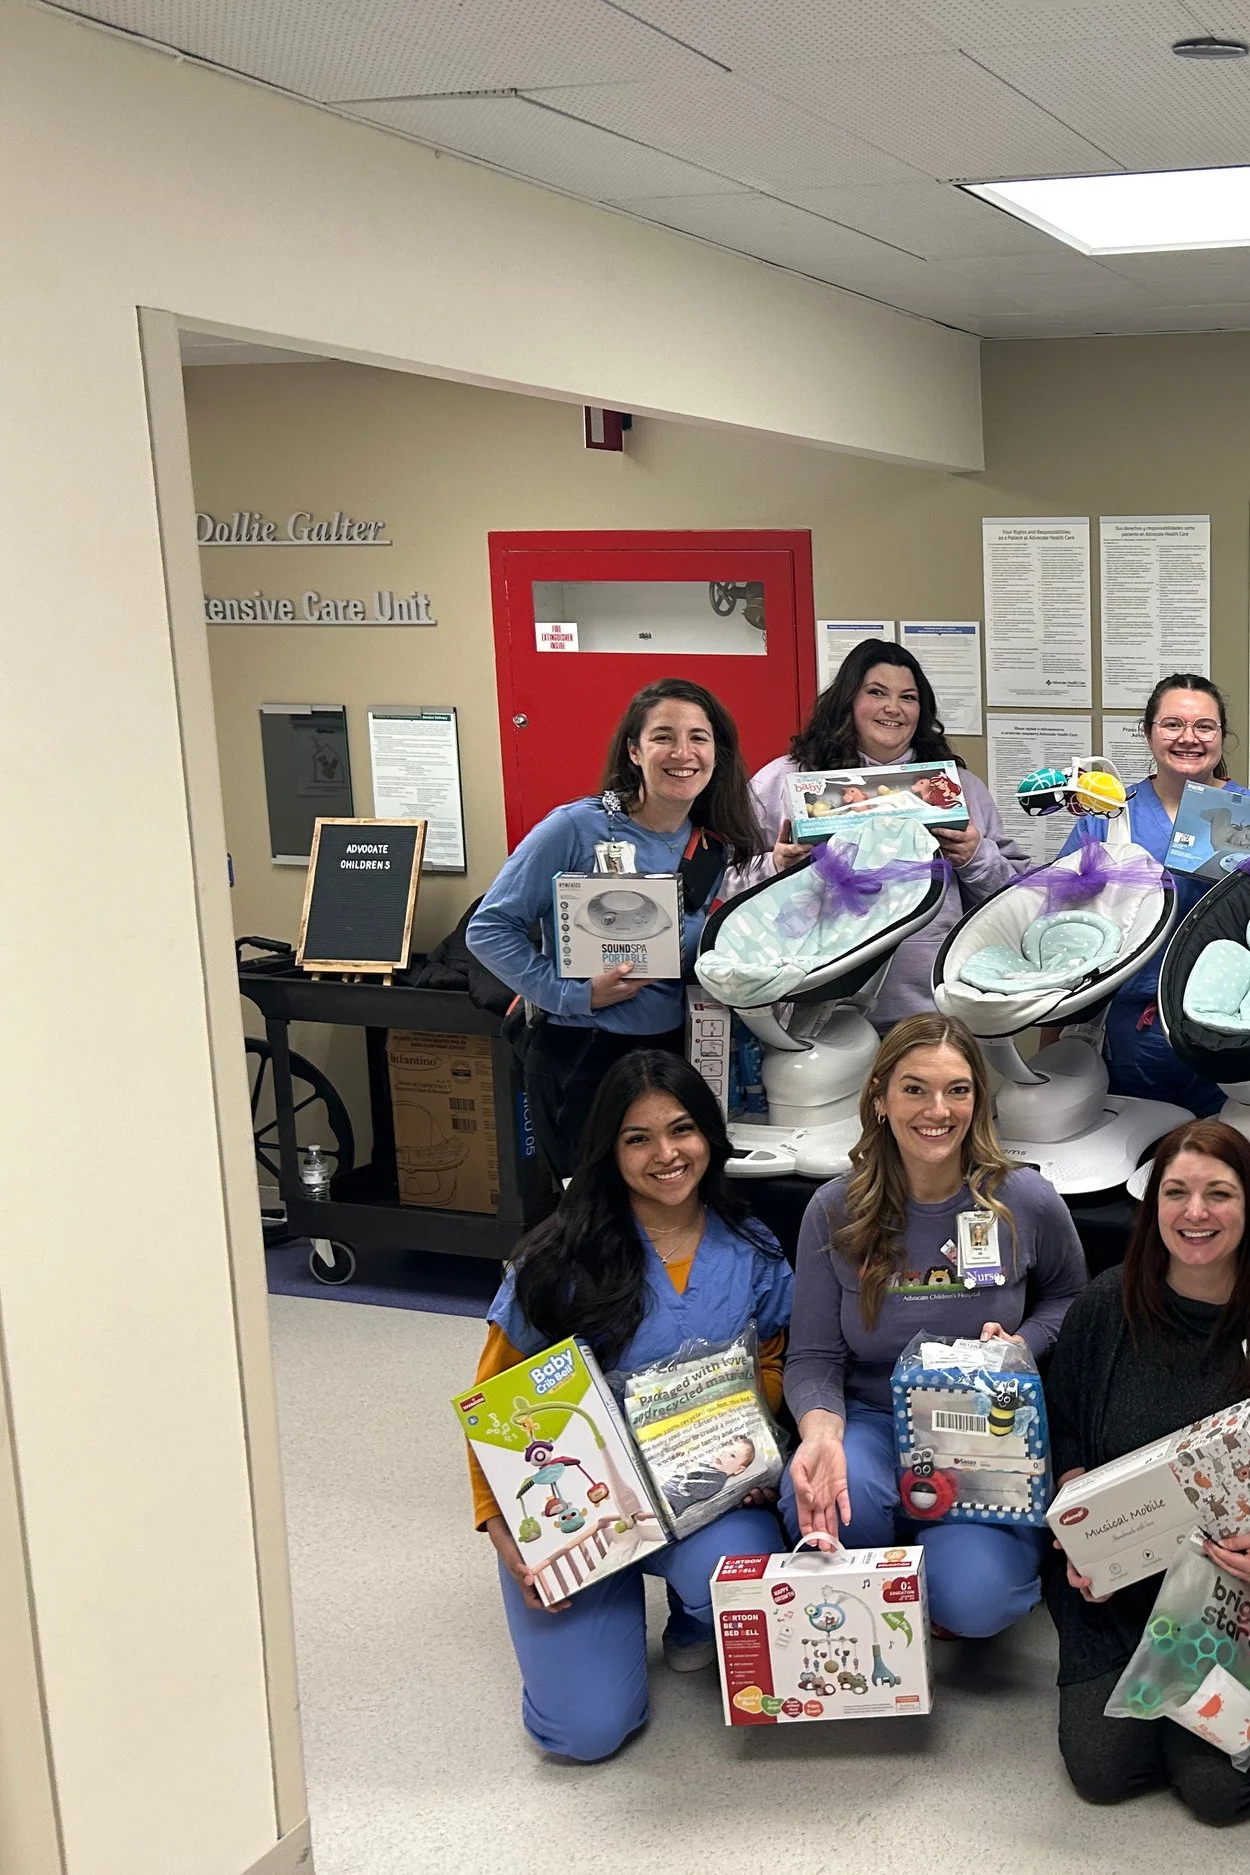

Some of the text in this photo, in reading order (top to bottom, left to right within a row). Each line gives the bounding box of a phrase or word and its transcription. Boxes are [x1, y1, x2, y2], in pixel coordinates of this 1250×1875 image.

[196, 511, 384, 542] Dollie Galter
[303, 591, 366, 621] Care
[374, 591, 431, 621] Unit
[794, 781, 823, 794] baby
[346, 844, 389, 854] ADVOCATE
[602, 943, 648, 953] SOUNDSPA
[602, 953, 648, 964] PORTABLE
[390, 1052, 437, 1067] Infantino
[525, 1136, 536, 1156] 05
[903, 1294, 929, 1302] Advocate
[930, 1293, 956, 1301] Children's
[531, 1350, 573, 1384] Baby
[537, 1364, 573, 1394] Crib Bell
[639, 1377, 690, 1407] Packaged
[691, 1361, 720, 1382] with
[653, 1386, 704, 1418] recycled
[1085, 1514, 1128, 1539] Musical
[1130, 1498, 1166, 1520] Mobile
